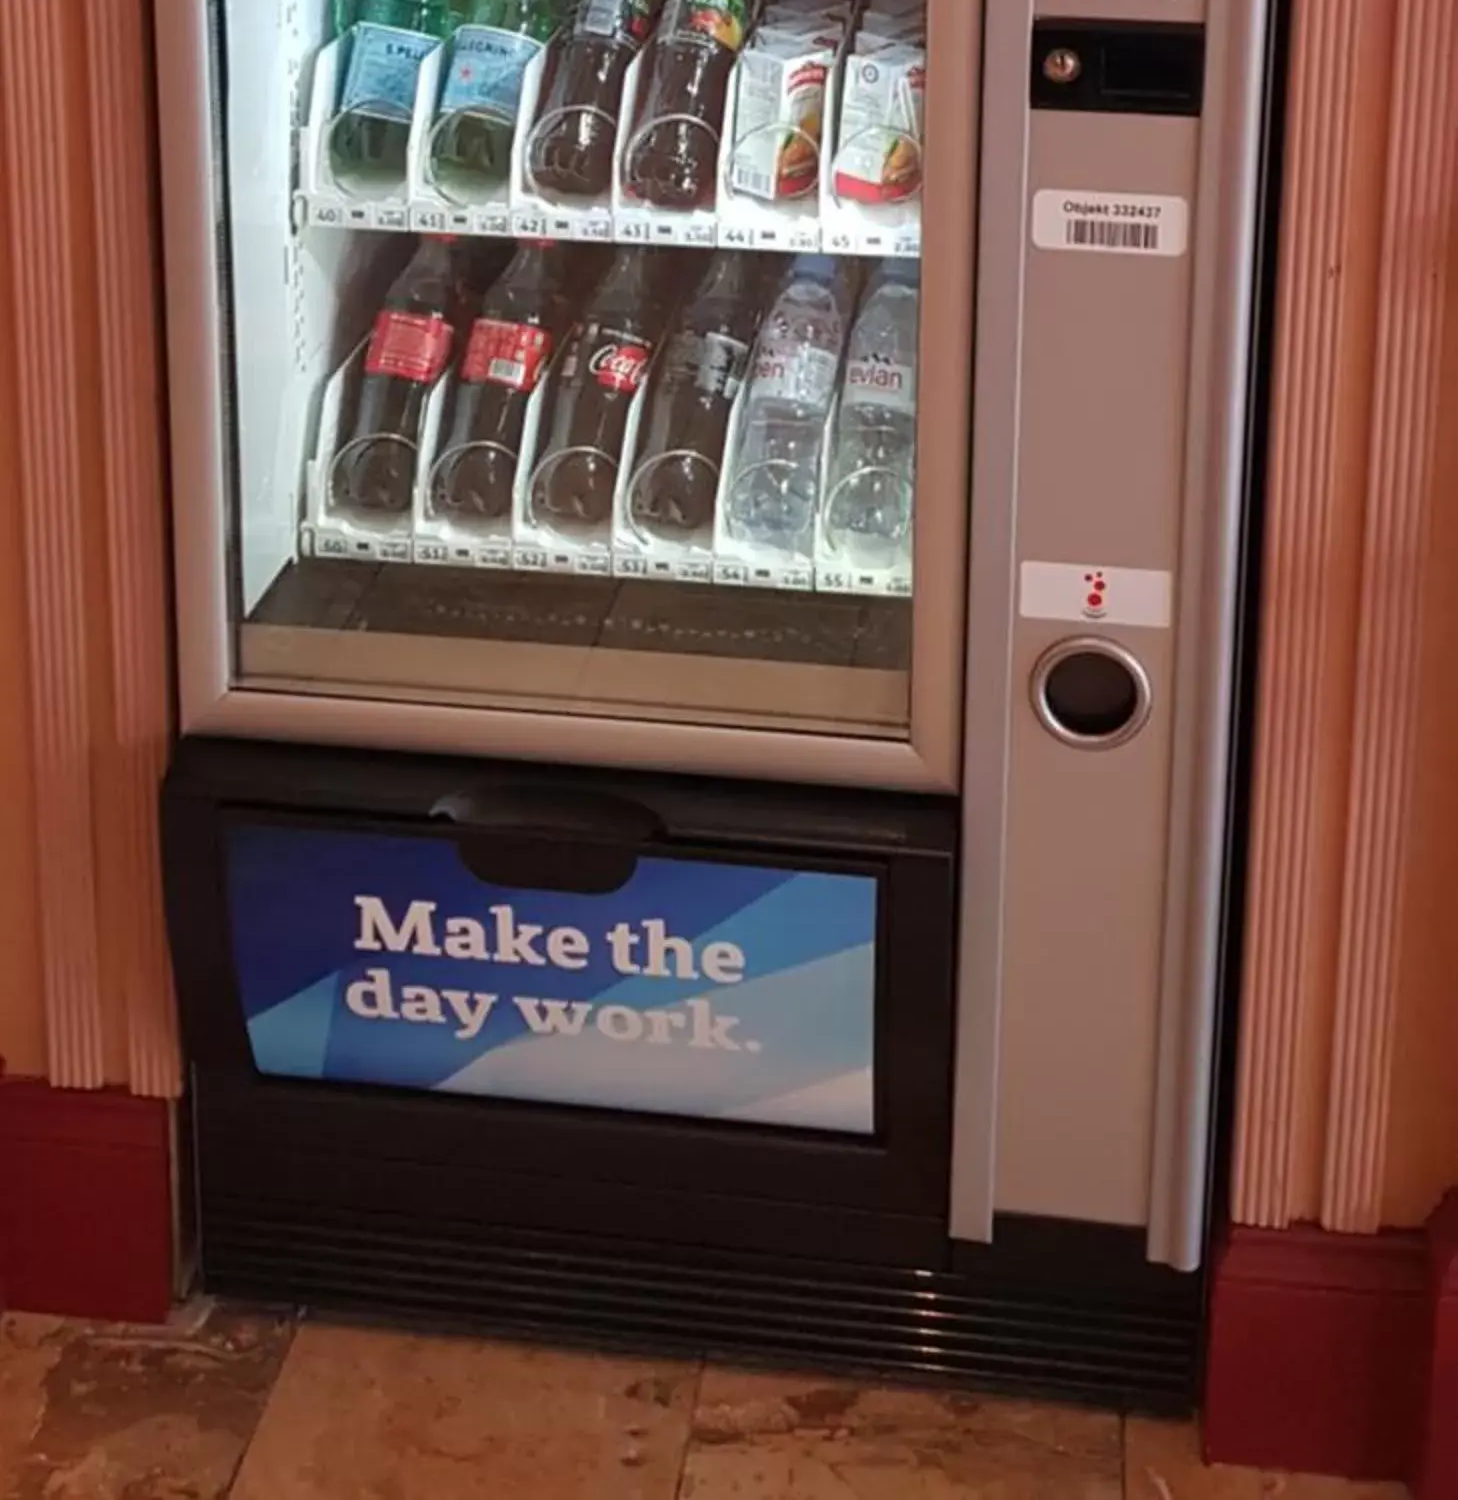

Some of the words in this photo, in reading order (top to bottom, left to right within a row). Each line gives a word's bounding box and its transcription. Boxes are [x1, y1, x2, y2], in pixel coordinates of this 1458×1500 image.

[316, 207, 336, 222] 40
[1062, 199, 1109, 217] Objekt
[418, 211, 438, 226] 41
[519, 216, 539, 232] 42
[622, 221, 641, 237] 43
[725, 227, 745, 243] 44
[831, 233, 850, 249] 45
[850, 365, 903, 389] evian
[421, 546, 440, 560] 51
[520, 551, 540, 566] 52
[622, 559, 640, 574] 53
[721, 566, 740, 581] 54
[824, 572, 843, 587] 55
[353, 895, 591, 970] Make
[605, 917, 747, 985] the
[344, 967, 498, 1040] day
[511, 996, 763, 1054] work.
